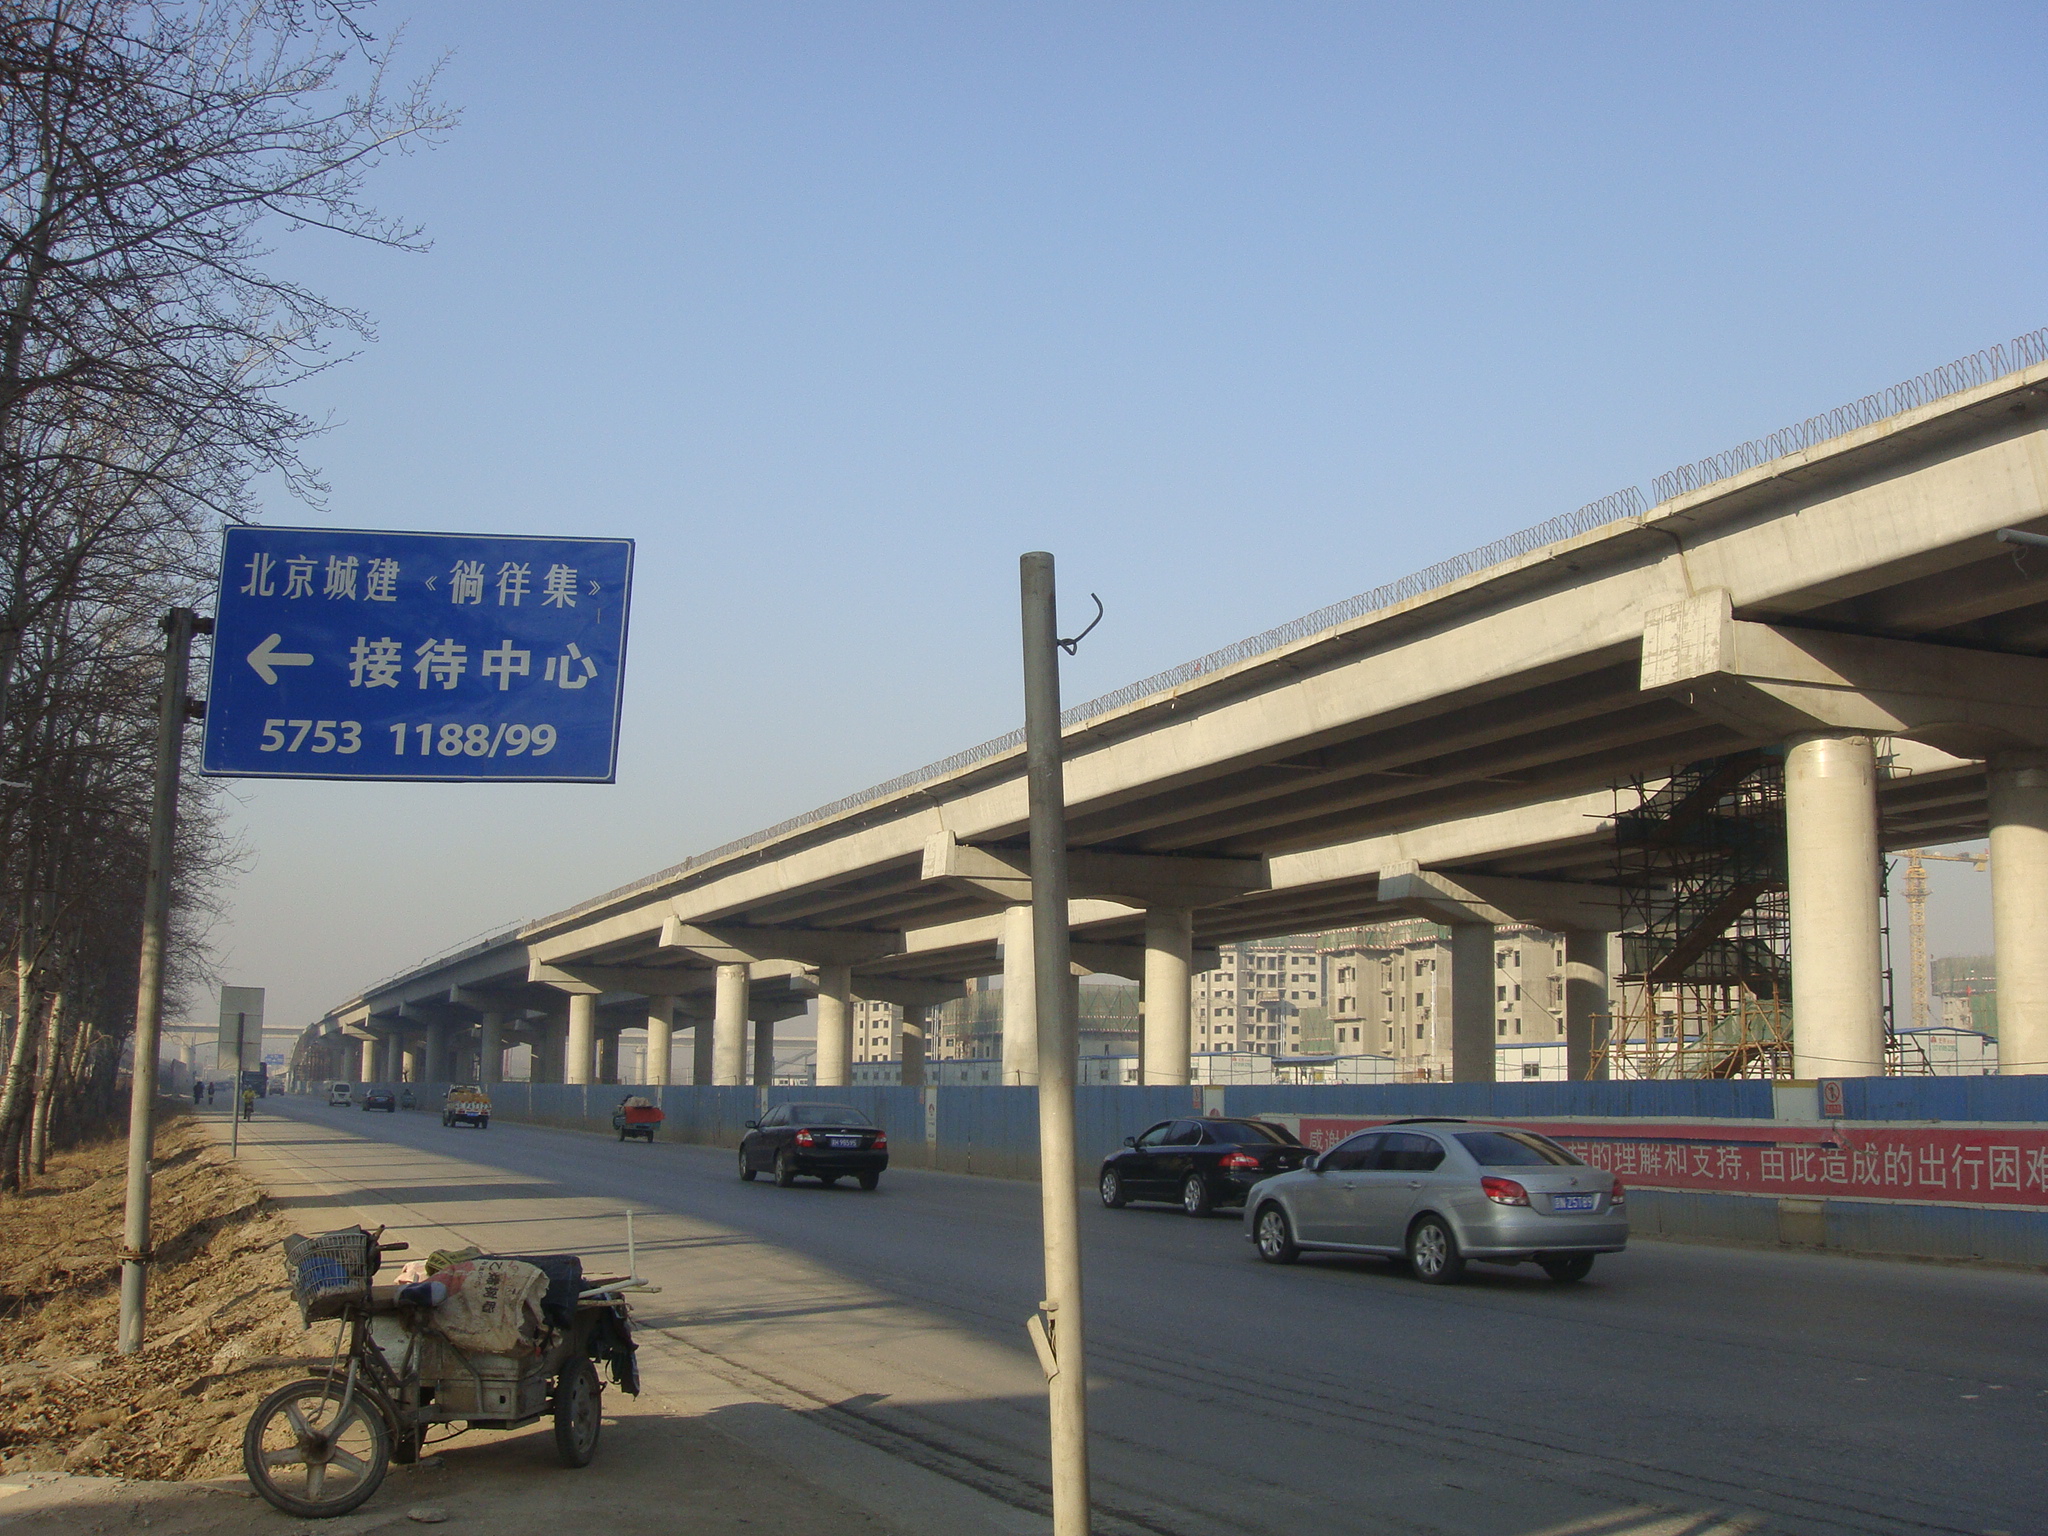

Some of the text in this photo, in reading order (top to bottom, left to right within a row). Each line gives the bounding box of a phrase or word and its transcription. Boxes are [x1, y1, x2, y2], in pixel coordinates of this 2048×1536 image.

[241, 552, 601, 608] 北京城建 《徜徉集》
[349, 636, 598, 691] 接待中心
[259, 718, 557, 758] 5753 1188/99
